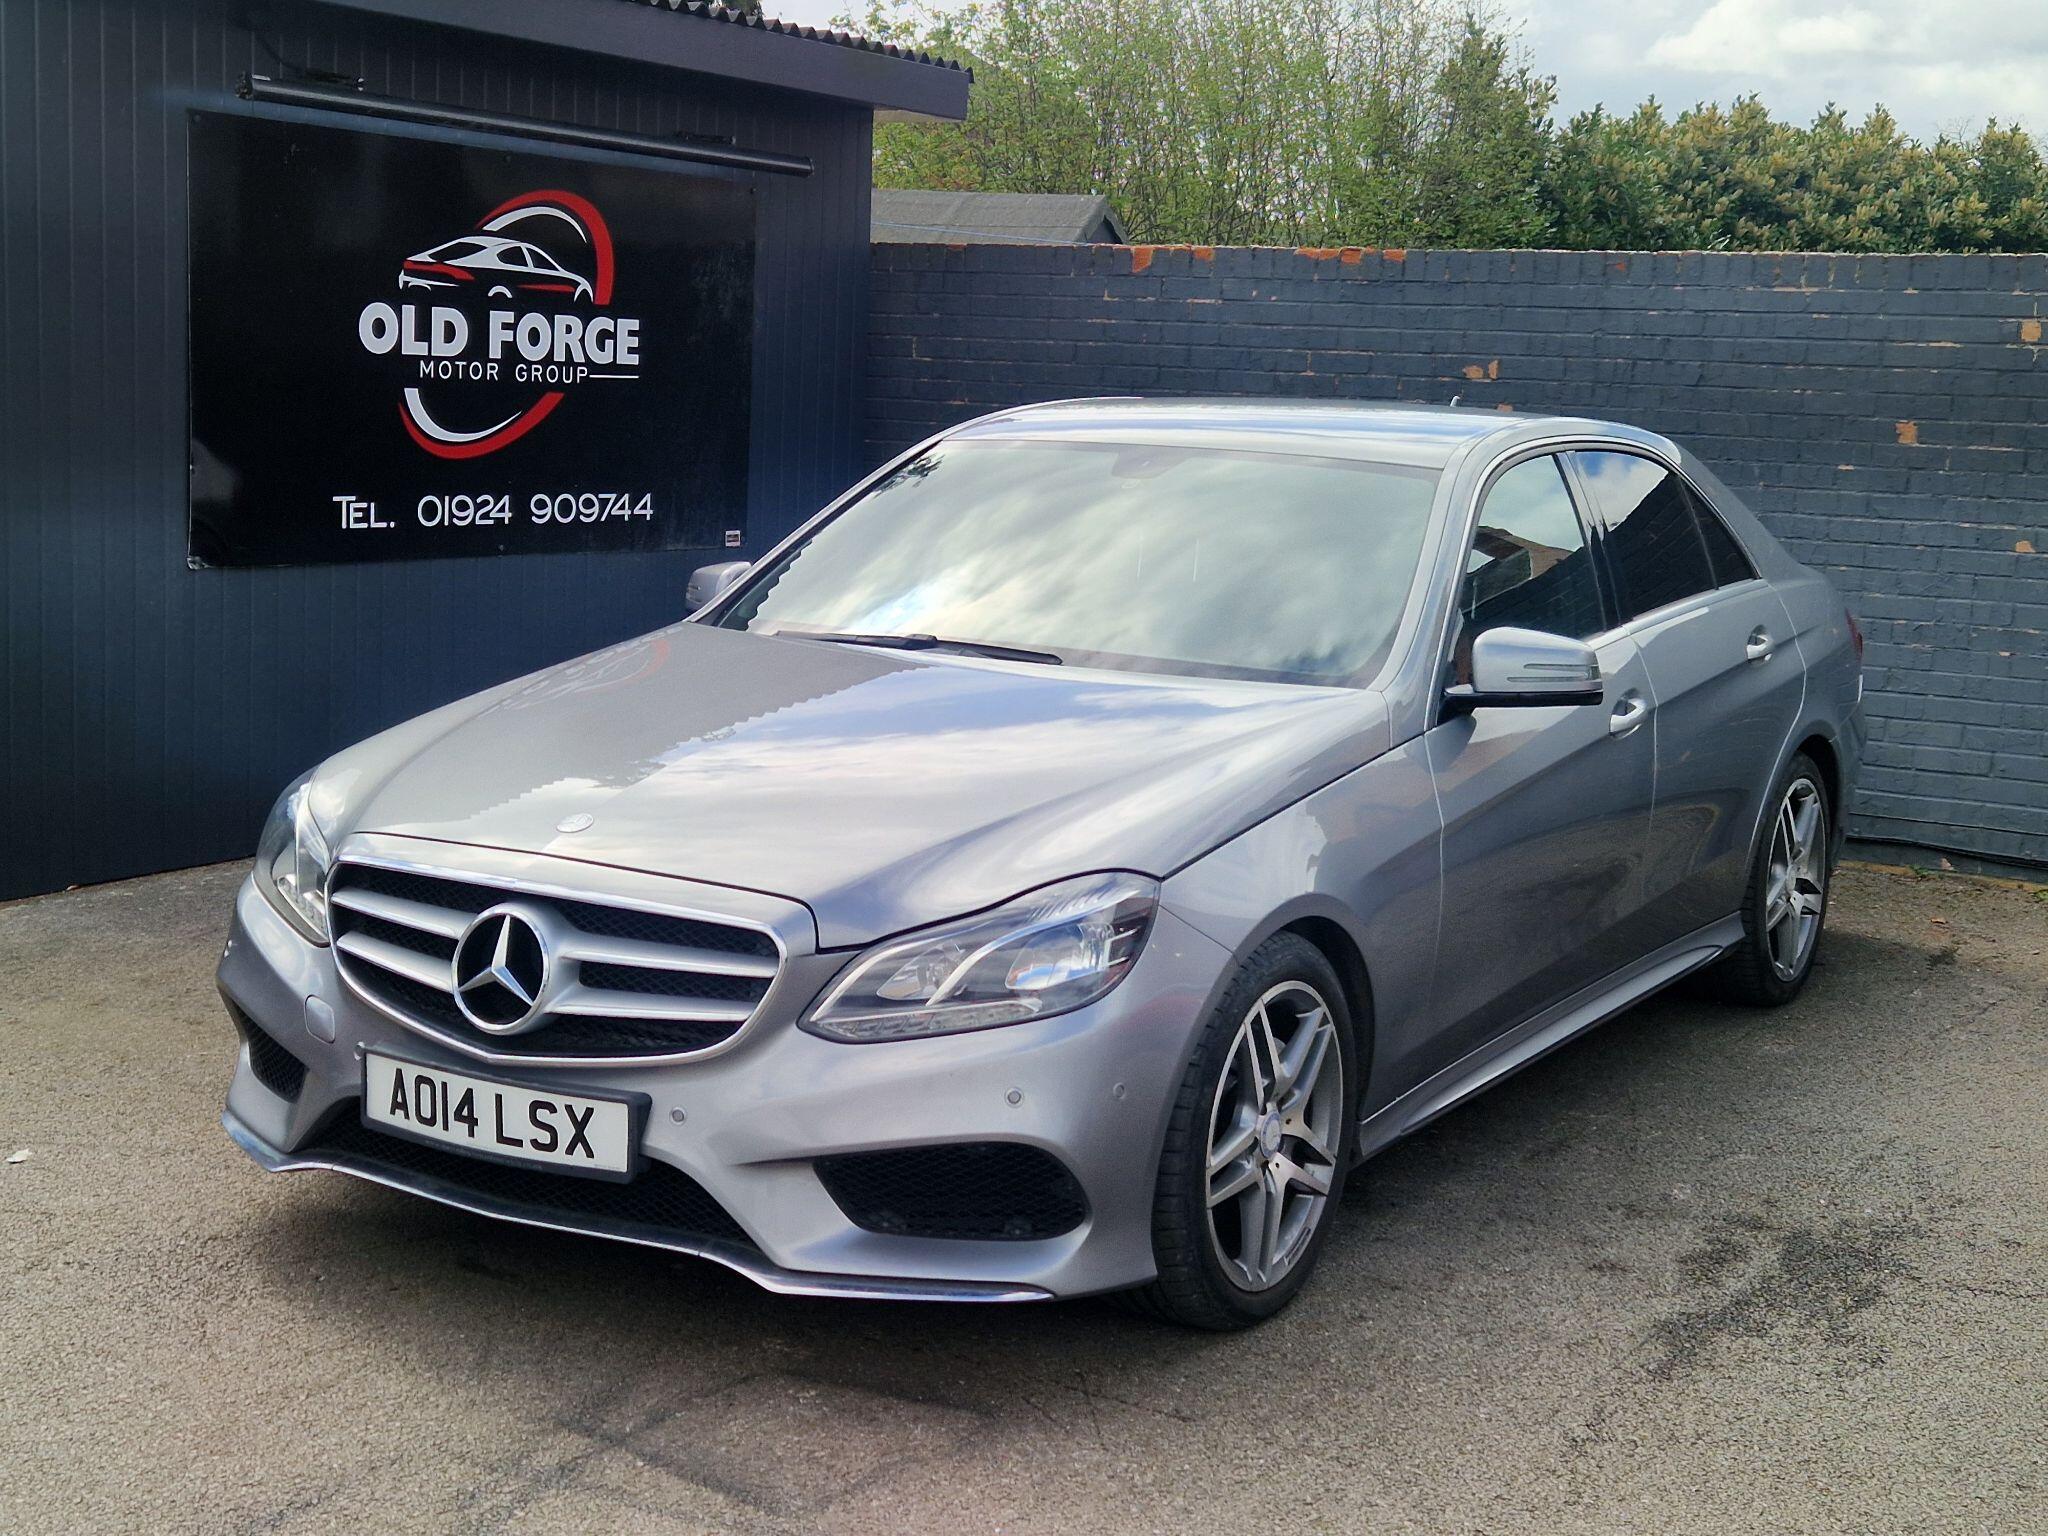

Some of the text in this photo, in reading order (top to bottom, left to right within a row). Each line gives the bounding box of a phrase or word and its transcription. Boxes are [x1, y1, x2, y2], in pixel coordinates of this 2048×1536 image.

[358, 302, 640, 365] OLD FORGE
[419, 359, 588, 383] MOTOR GROUP
[332, 492, 654, 529] TEL. 01924 909744
[389, 1067, 479, 1139] AO14
[494, 1093, 595, 1159] LSX
